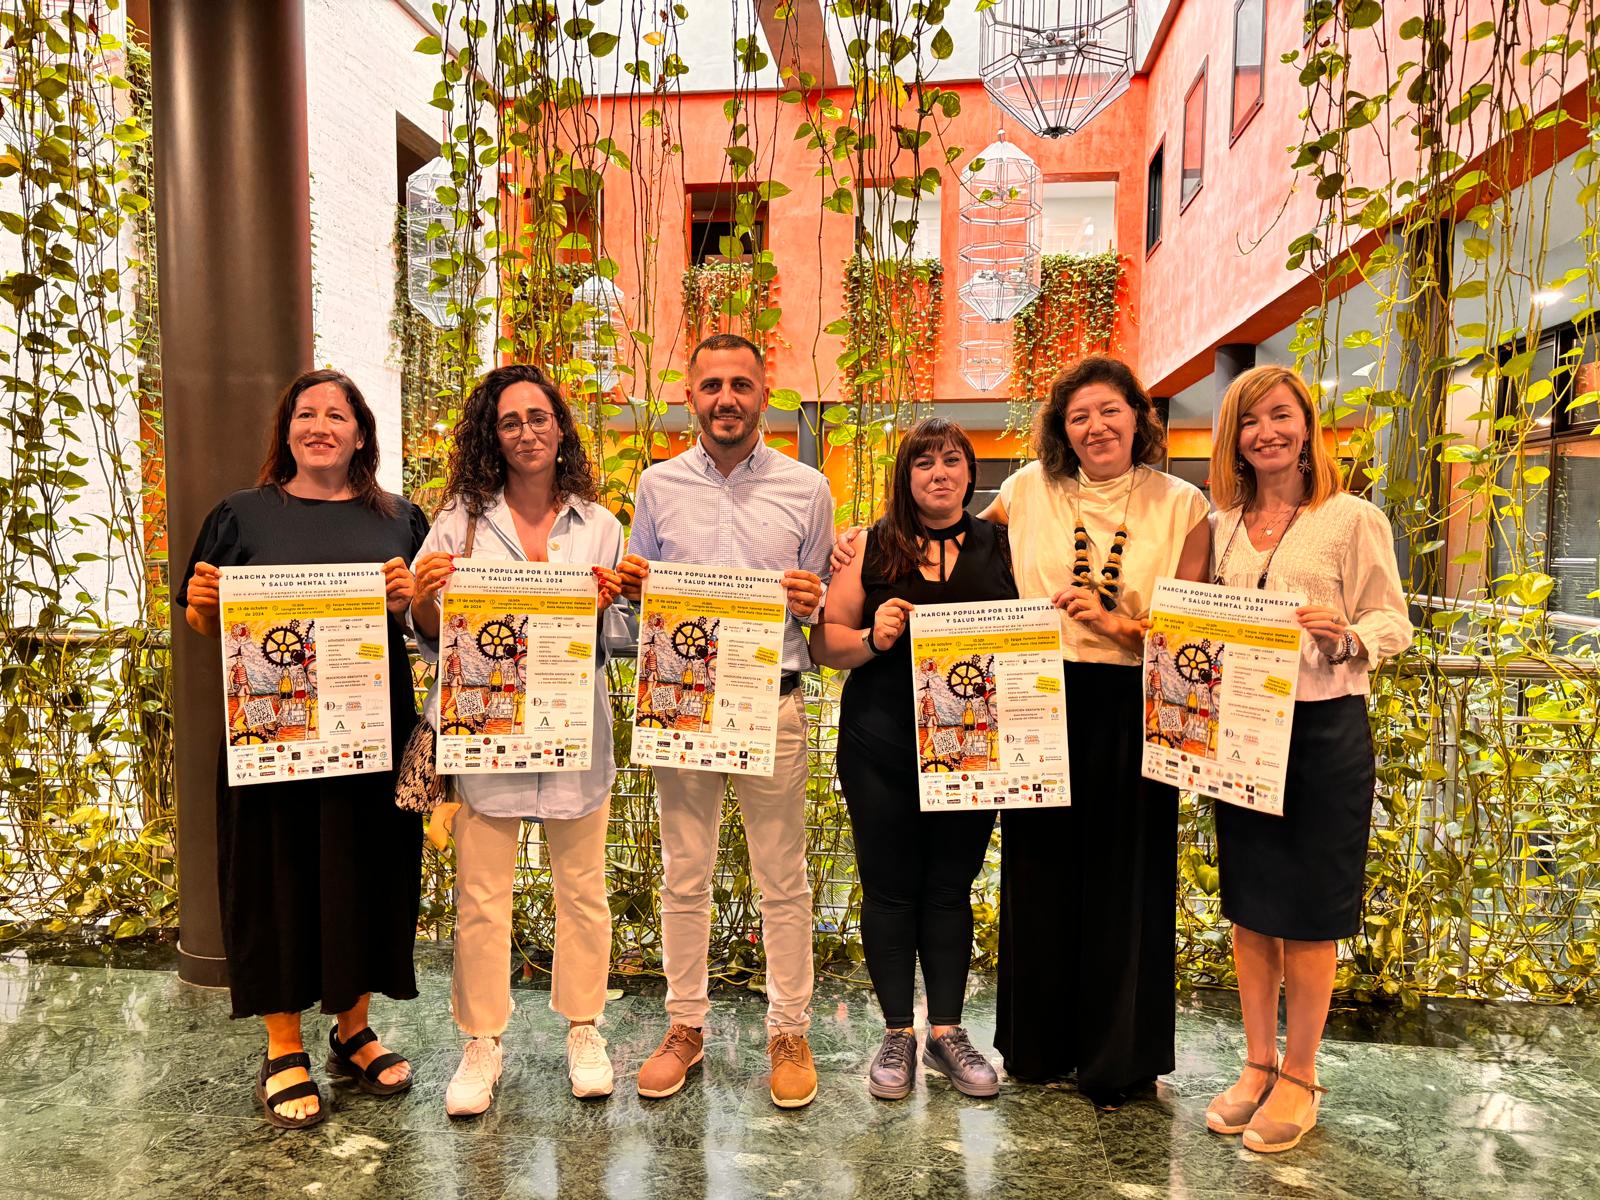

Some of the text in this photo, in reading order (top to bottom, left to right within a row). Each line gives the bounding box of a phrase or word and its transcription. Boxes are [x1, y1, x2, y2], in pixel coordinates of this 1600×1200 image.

[1163, 586, 1188, 594] MARCHA
[1190, 590, 1223, 598] POPULAR
[1256, 598, 1300, 607] BIENESTAR
[1214, 601, 1242, 609] MENTAL
